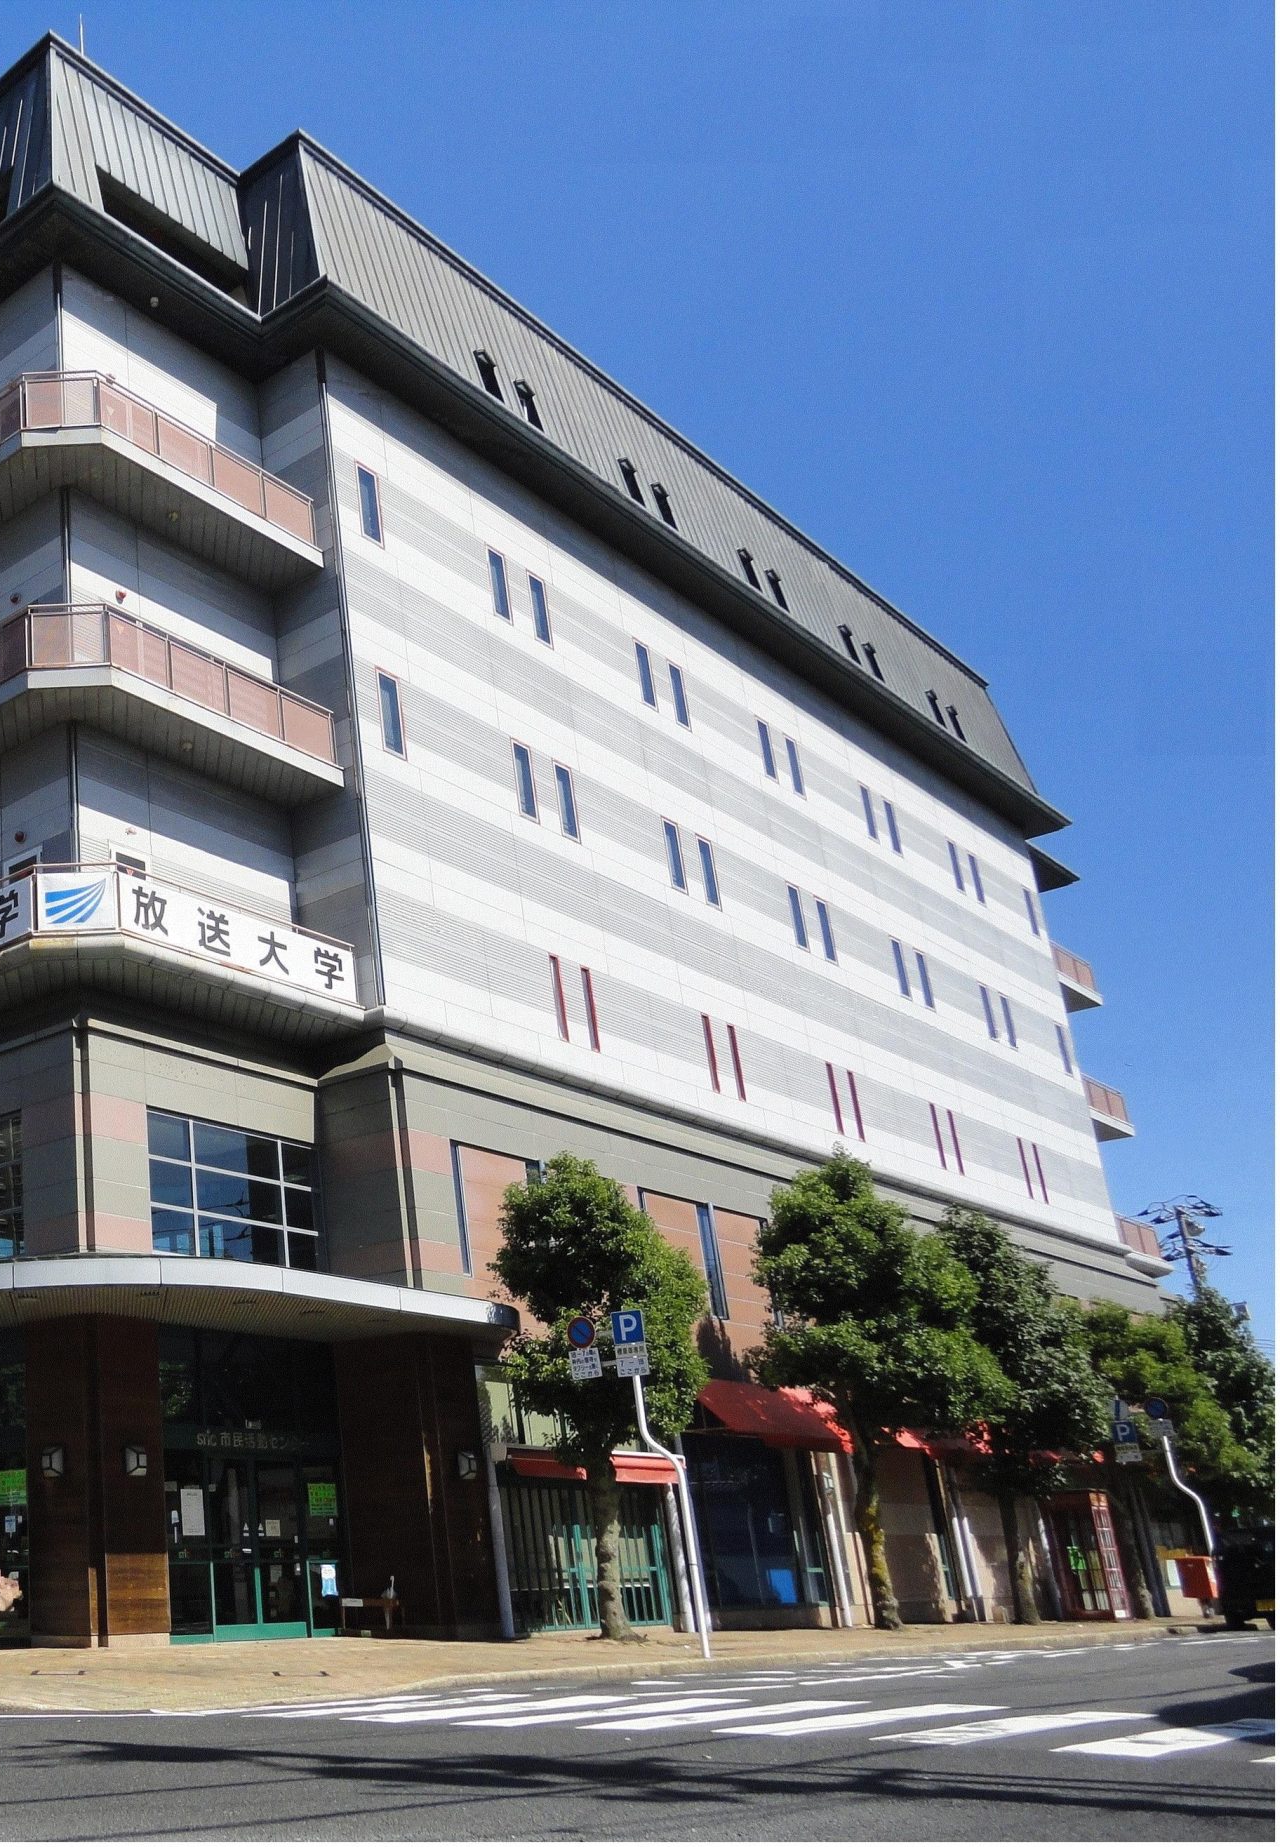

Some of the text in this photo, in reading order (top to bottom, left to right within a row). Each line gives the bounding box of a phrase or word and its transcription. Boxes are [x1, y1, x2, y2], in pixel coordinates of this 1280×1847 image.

[131, 885, 345, 990] 放送大学
[619, 1314, 637, 1341] P
